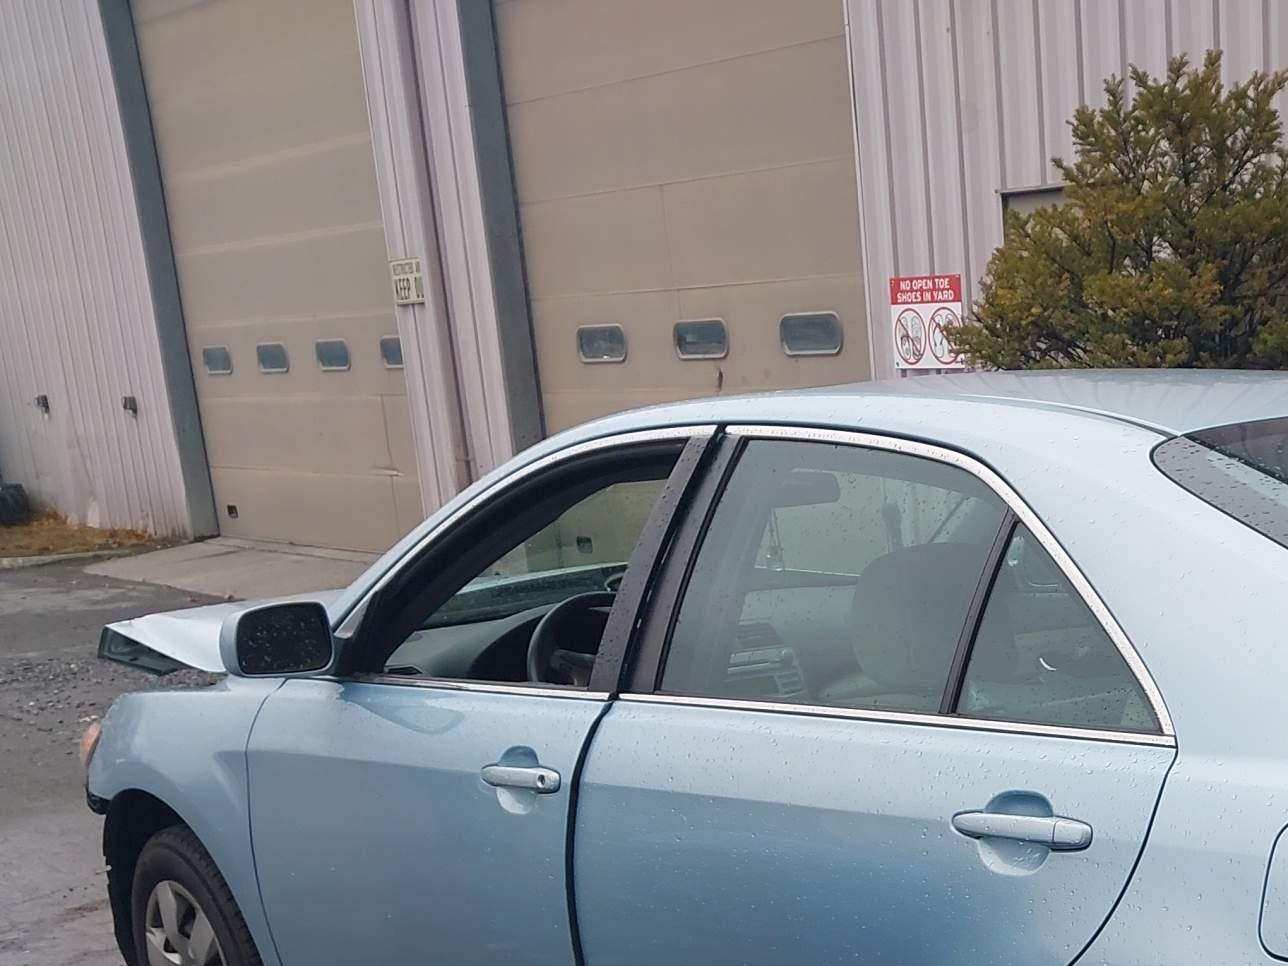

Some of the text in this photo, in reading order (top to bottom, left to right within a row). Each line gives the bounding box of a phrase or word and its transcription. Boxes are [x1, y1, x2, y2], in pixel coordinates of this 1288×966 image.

[900, 278, 950, 290] NO OPEN TOE
[897, 290, 954, 302] SHOES IN YARD
